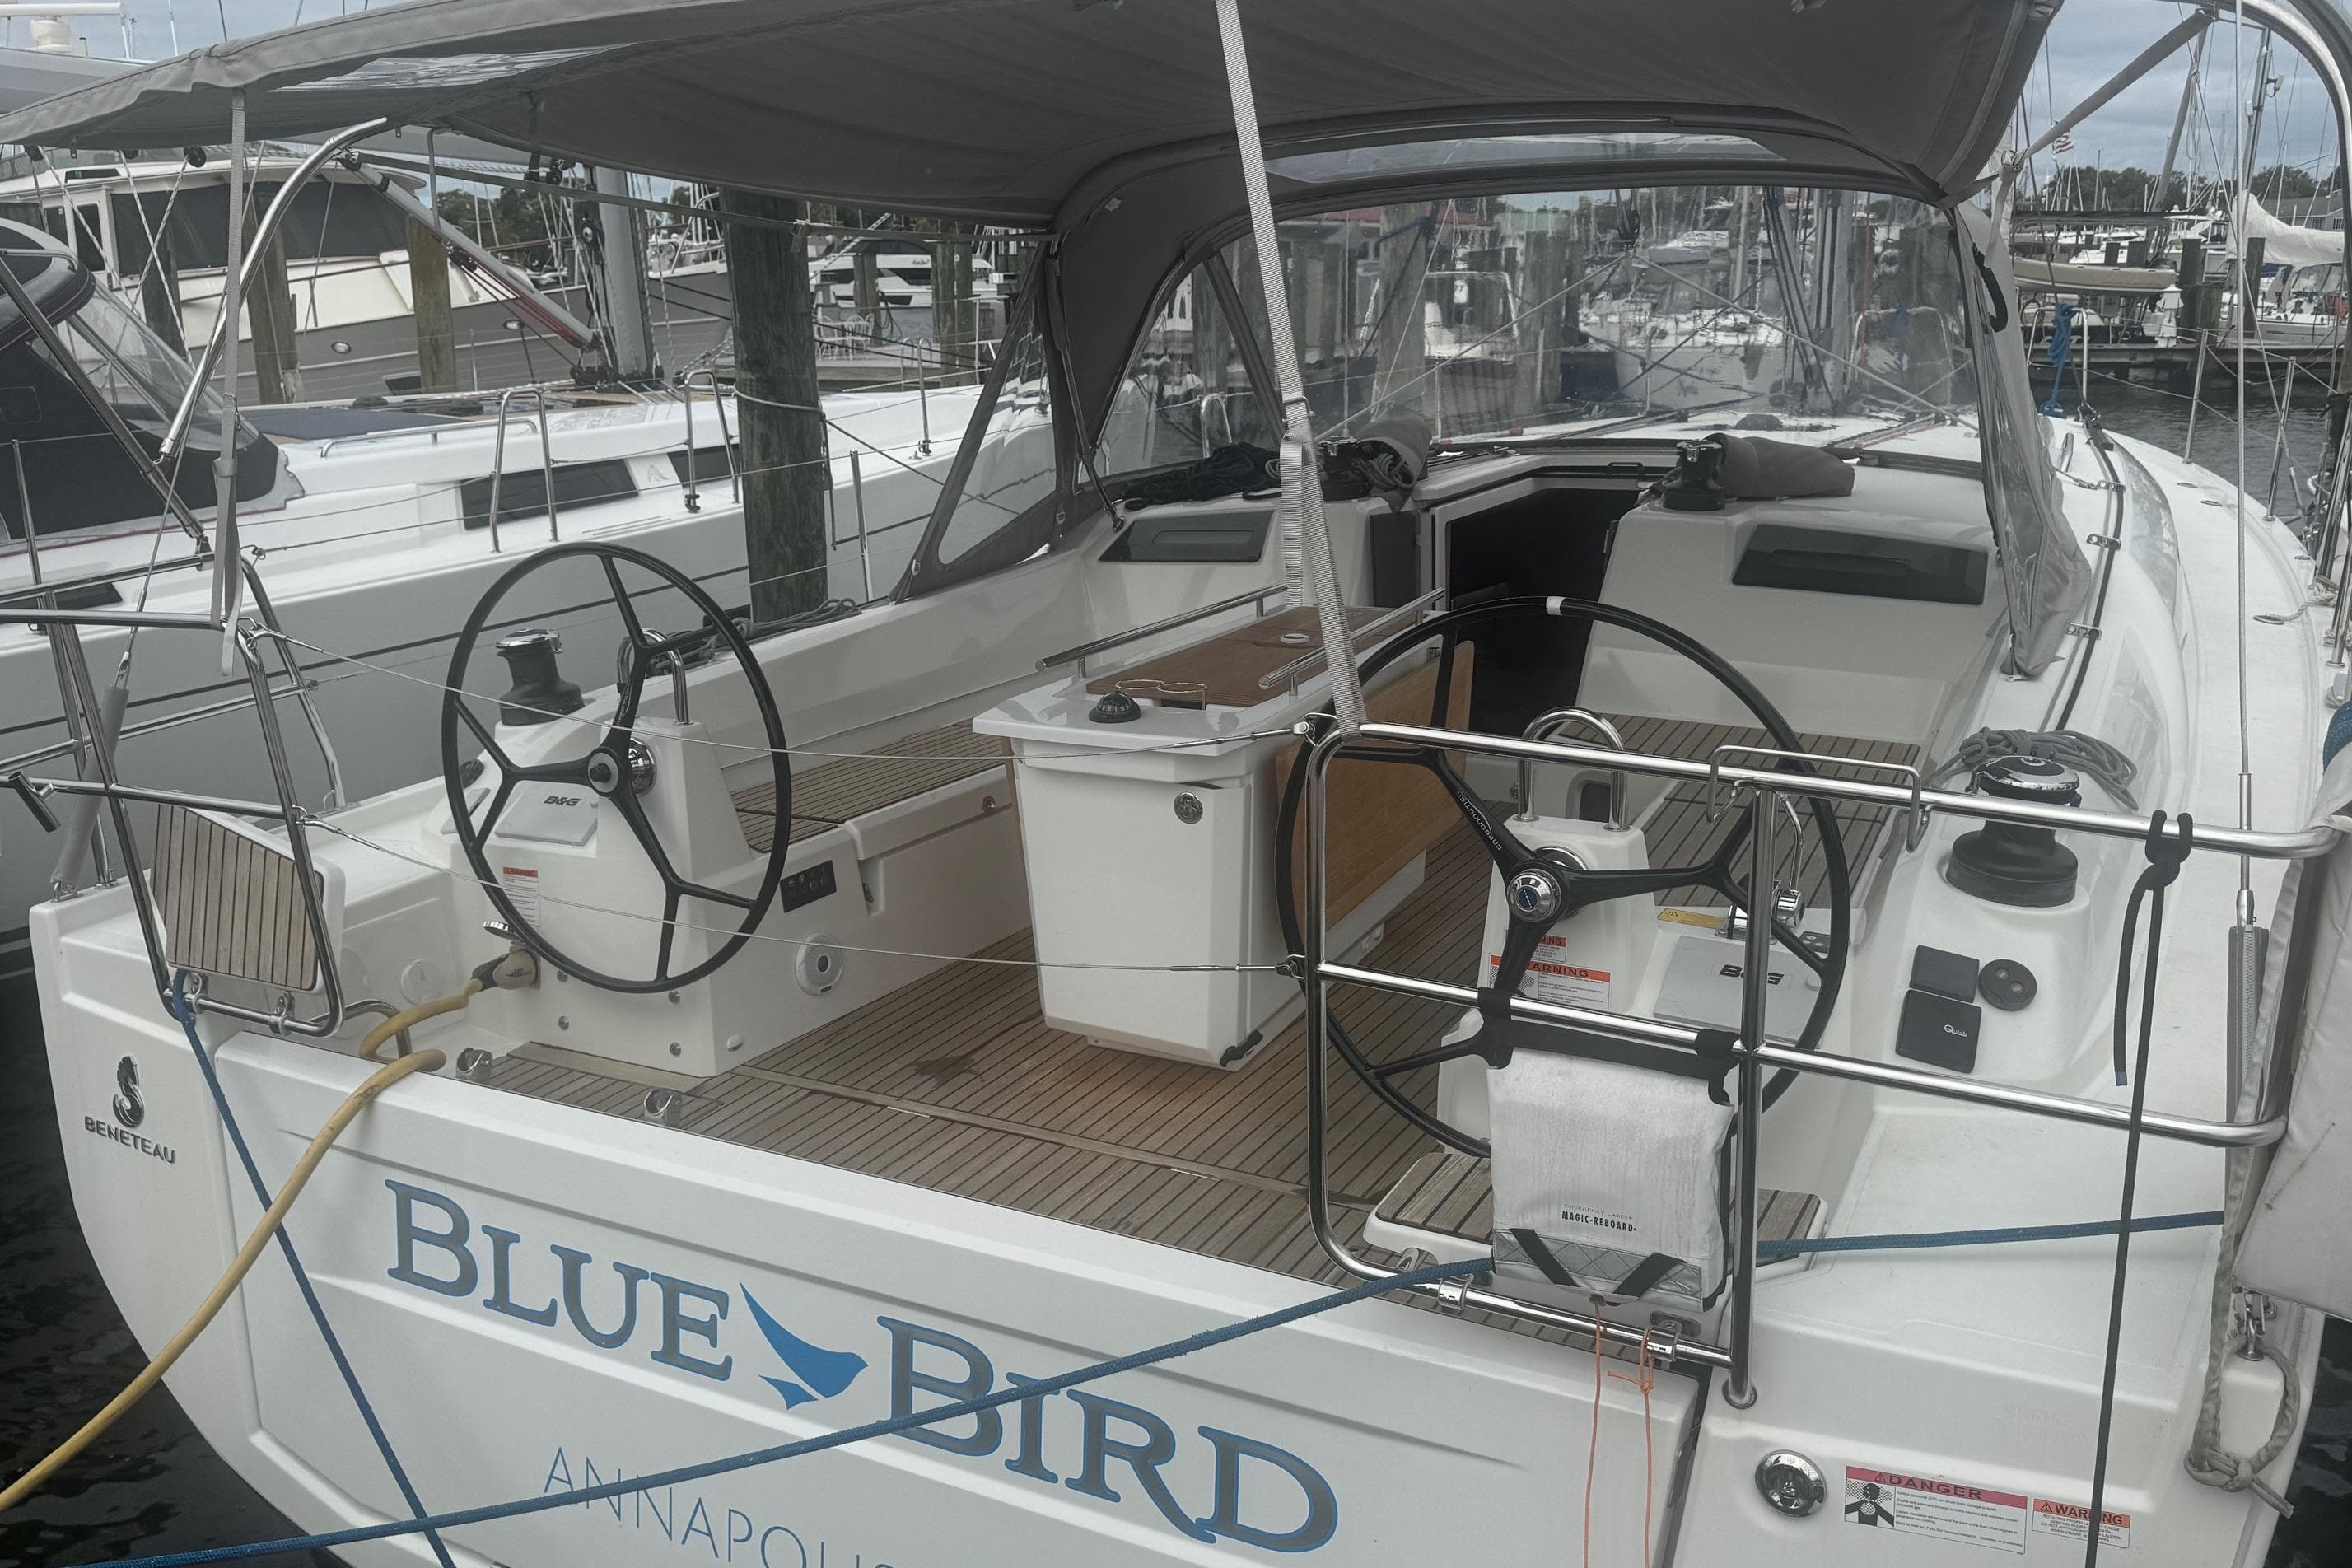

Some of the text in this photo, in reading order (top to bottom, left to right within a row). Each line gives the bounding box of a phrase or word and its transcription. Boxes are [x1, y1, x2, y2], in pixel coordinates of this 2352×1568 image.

[544, 796, 581, 806] B&G
[1531, 963, 1589, 978] ARNING
[1719, 964, 1785, 986] BG
[84, 1115, 176, 1164] BENETEAU
[385, 1178, 1338, 1553] BLUE BIRD
[1888, 1474, 1982, 1500] DANGER
[544, 1446, 894, 1568] ANNAPO
[2054, 1504, 2123, 1525] WARNG
